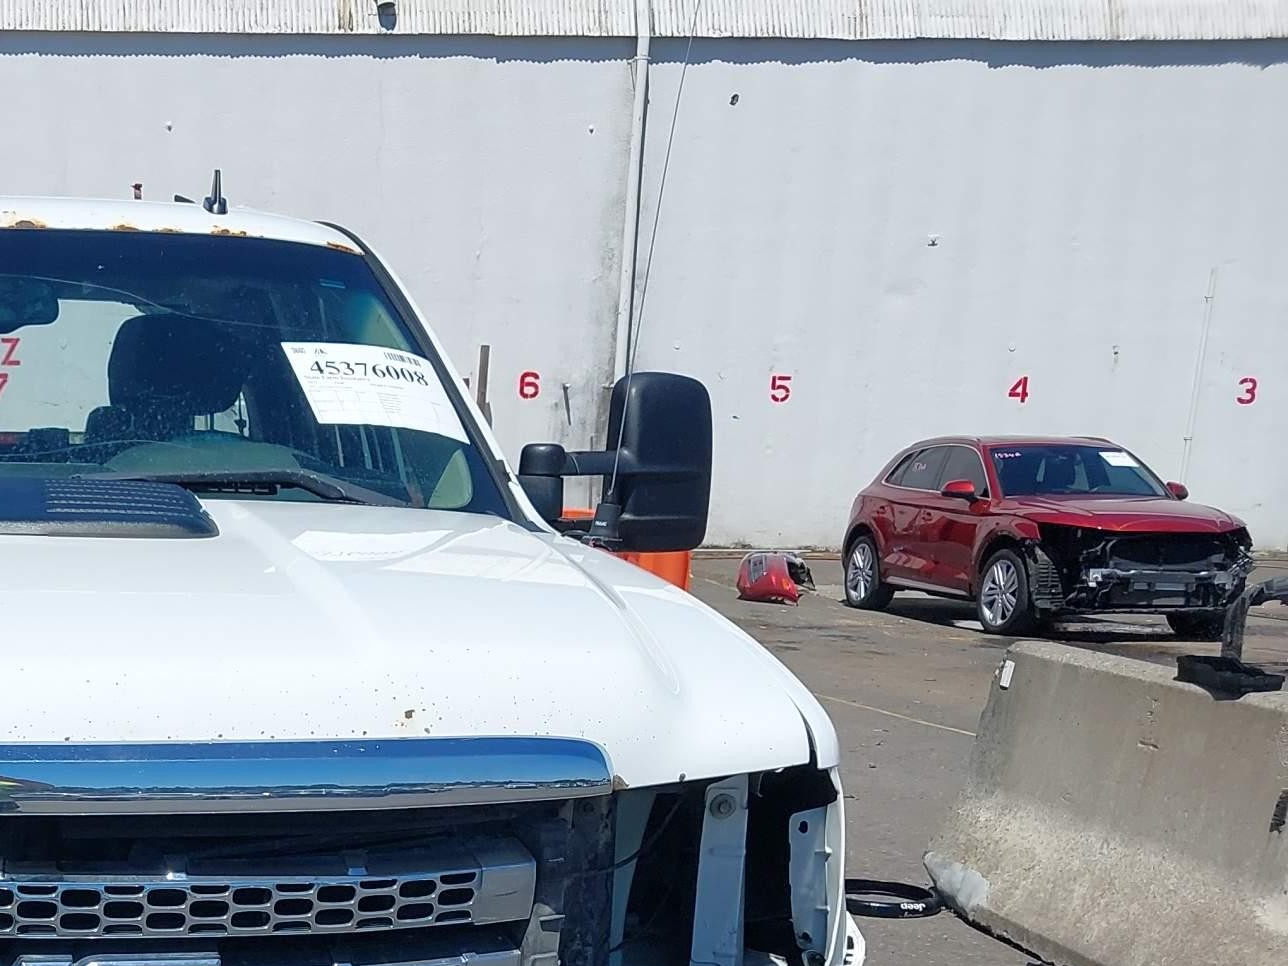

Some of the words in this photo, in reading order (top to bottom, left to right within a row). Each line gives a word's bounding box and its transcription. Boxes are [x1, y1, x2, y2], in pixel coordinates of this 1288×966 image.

[310, 360, 429, 386] 45376008
[518, 371, 540, 399] 6
[769, 375, 792, 403] 5
[1008, 376, 1030, 403] 4
[1236, 377, 1258, 405] 3
[900, 902, 926, 912] Jeep
